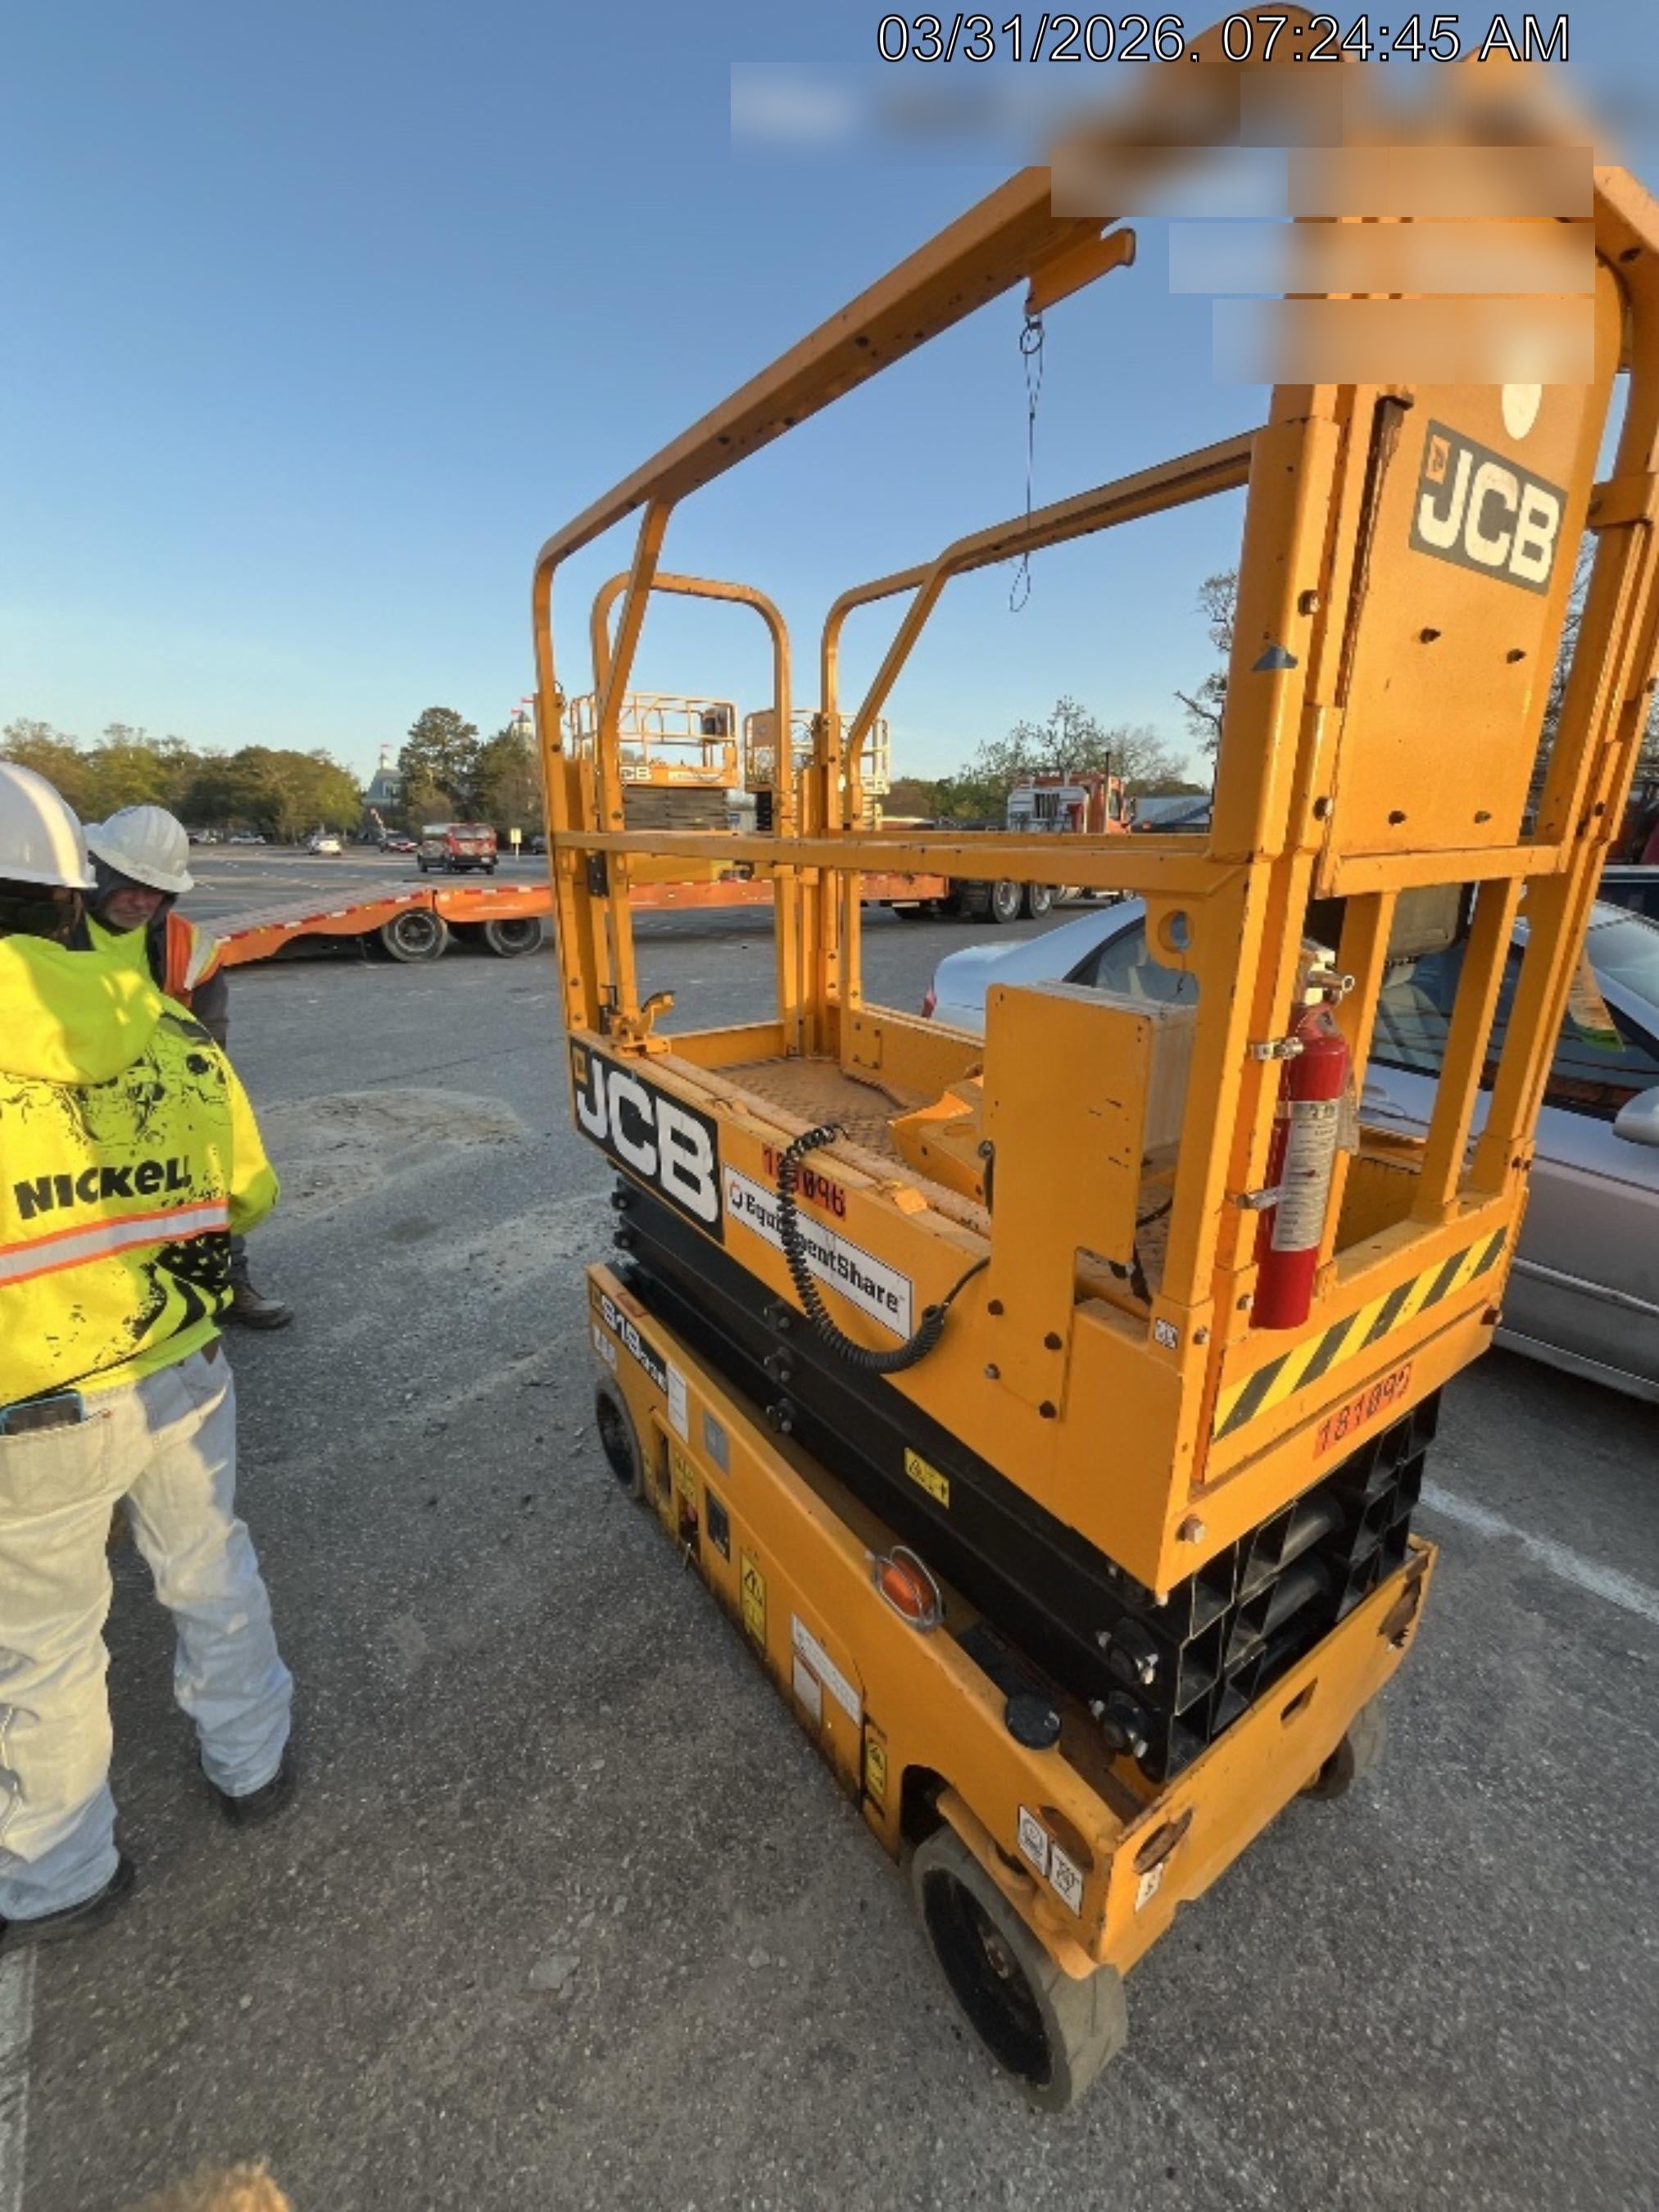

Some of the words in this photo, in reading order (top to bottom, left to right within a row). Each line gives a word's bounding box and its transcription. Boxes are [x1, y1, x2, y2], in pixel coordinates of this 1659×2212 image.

[1417, 449, 1560, 584] JCB
[577, 1058, 718, 1223] JCB
[763, 1146, 846, 1219] 1096
[746, 1190, 899, 1314] EquientShare
